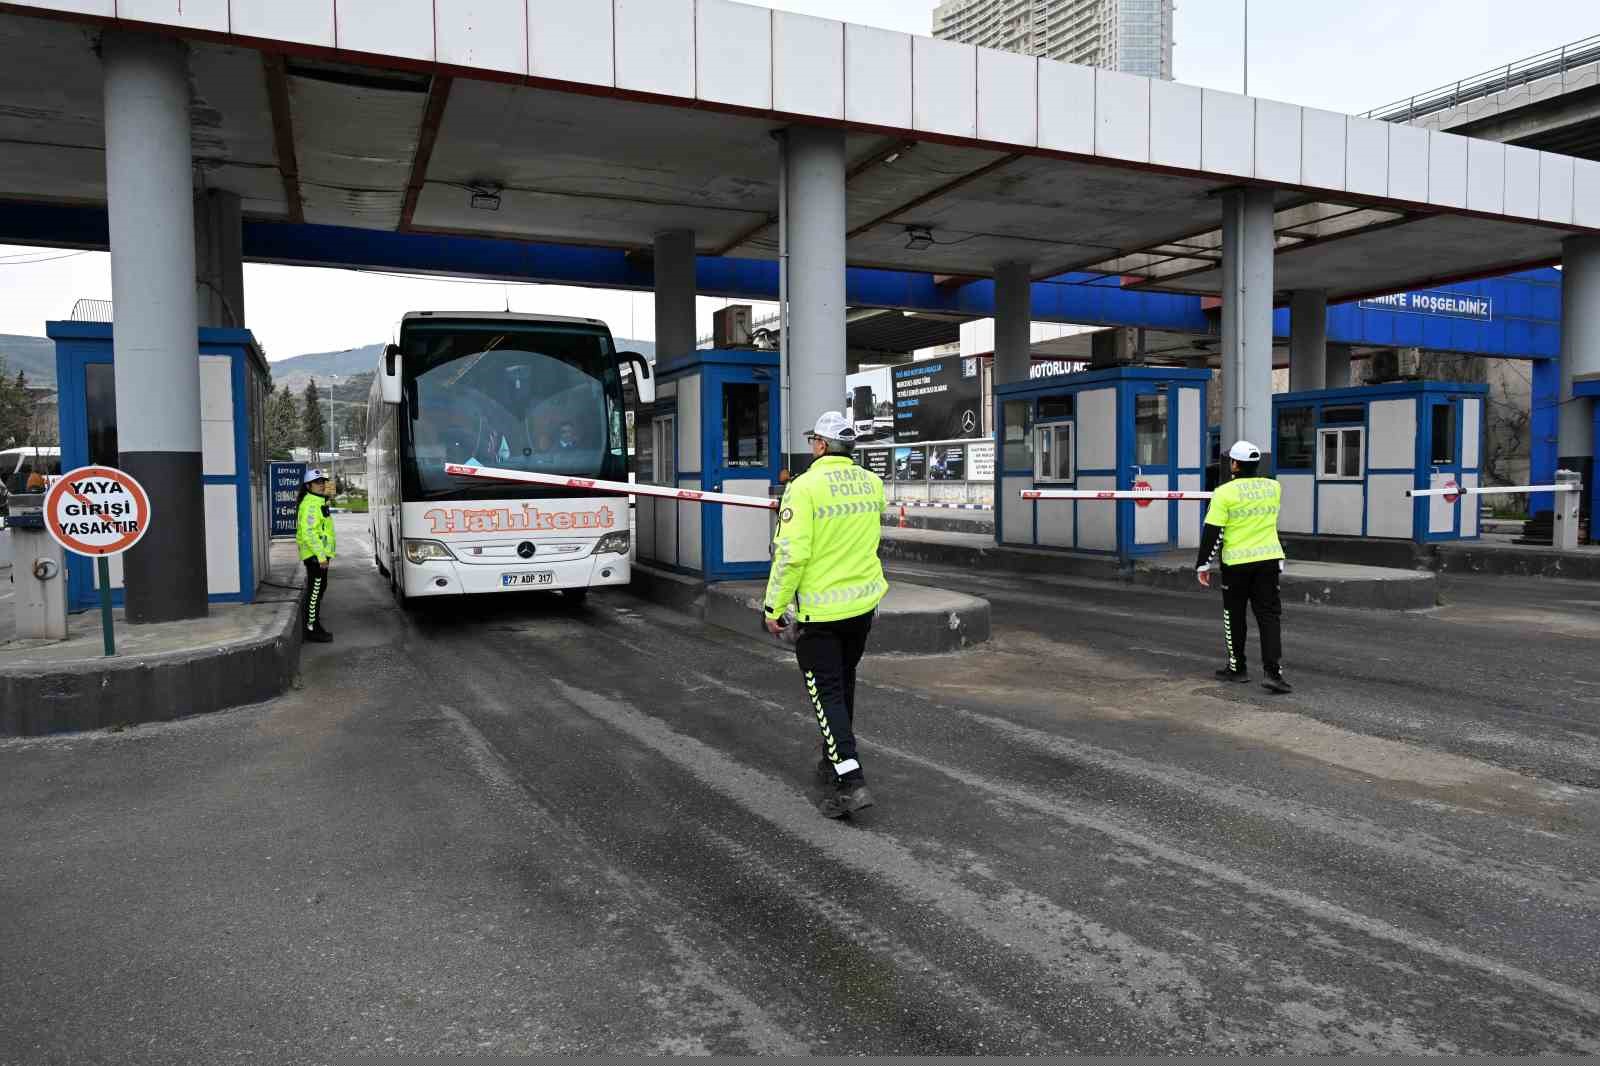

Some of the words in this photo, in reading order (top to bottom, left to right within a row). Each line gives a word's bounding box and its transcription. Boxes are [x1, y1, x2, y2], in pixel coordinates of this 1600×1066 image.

[1412, 294, 1488, 315] HOŞGELDİNİZ
[1029, 361, 1071, 379] MOTORLU
[70, 482, 124, 495] YAYA
[65, 500, 130, 518] GİRİŞİ
[59, 520, 138, 535] YASAKTIR
[521, 574, 535, 584] ADP
[538, 573, 551, 583] 317
